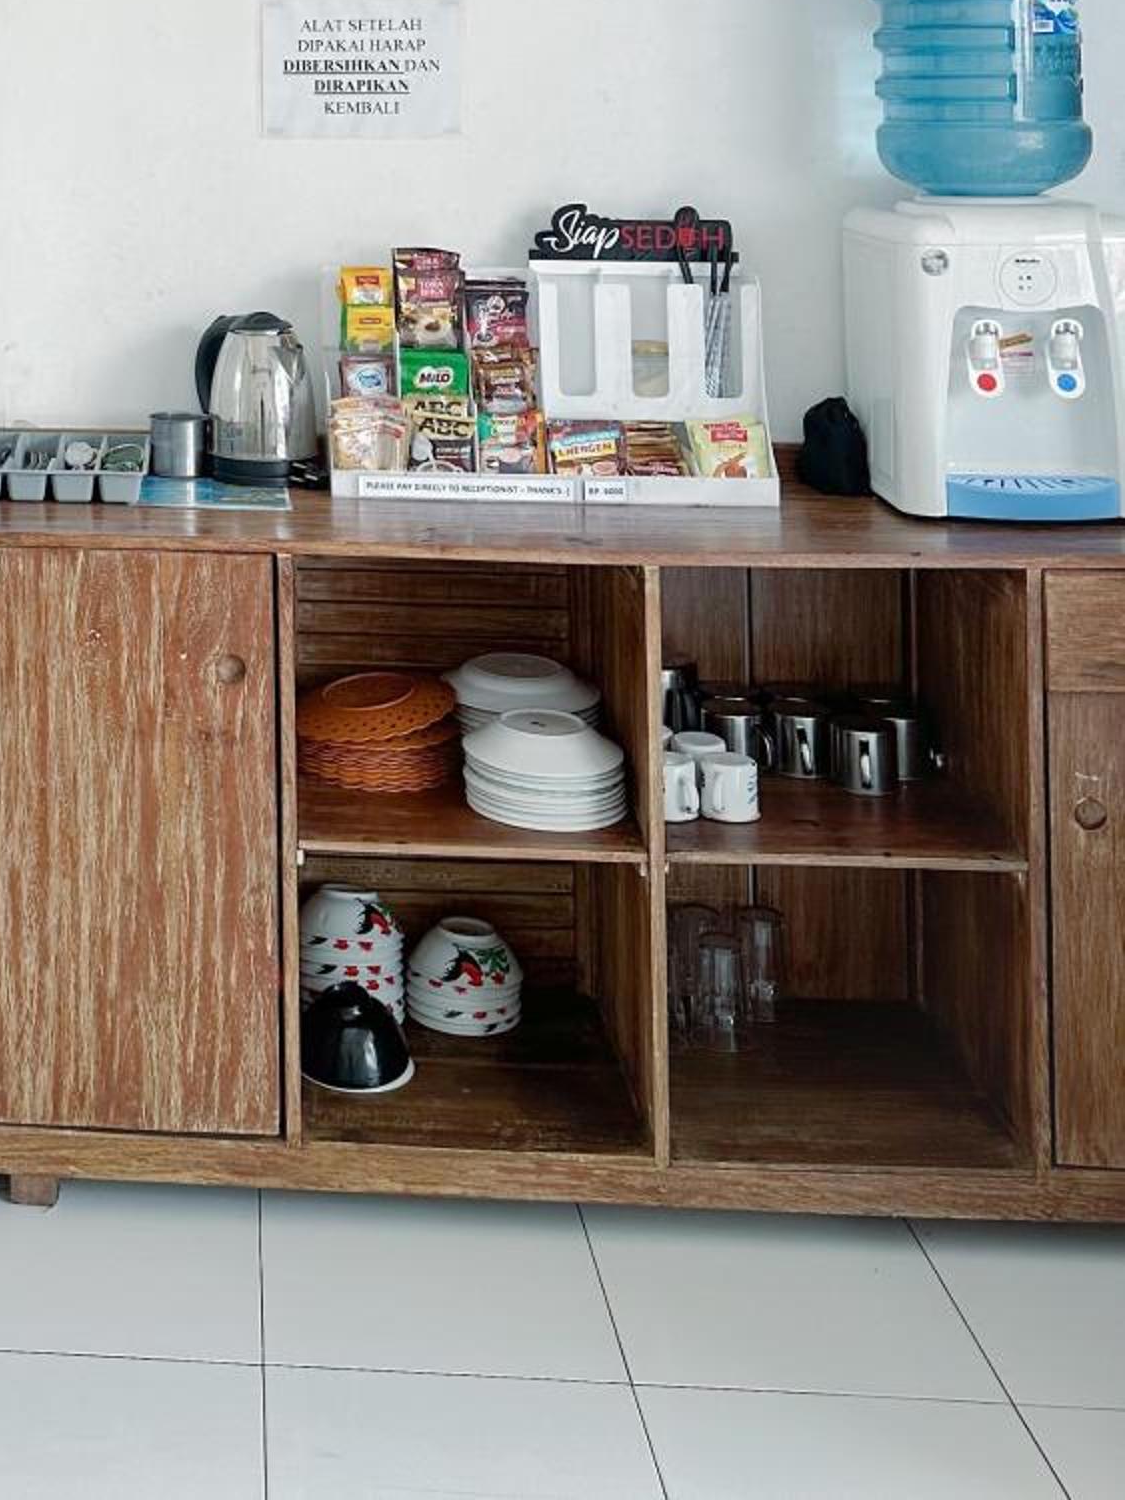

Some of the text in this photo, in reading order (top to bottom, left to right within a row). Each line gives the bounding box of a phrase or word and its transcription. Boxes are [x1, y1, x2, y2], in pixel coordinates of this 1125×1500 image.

[300, 18, 422, 33] ALAT SETELAH
[297, 38, 426, 53] DIPAKAI HARAP
[283, 58, 441, 74] DIBERSIHKAN DAN
[314, 78, 411, 94] DIRAPIKAN
[324, 101, 400, 116] KEMBALI
[543, 209, 619, 259] Siap
[419, 371, 450, 384] MILO
[418, 418, 470, 437] ABC
[366, 481, 394, 491] PLEASE
[396, 482, 412, 491] PAY
[448, 483, 460, 493] TO
